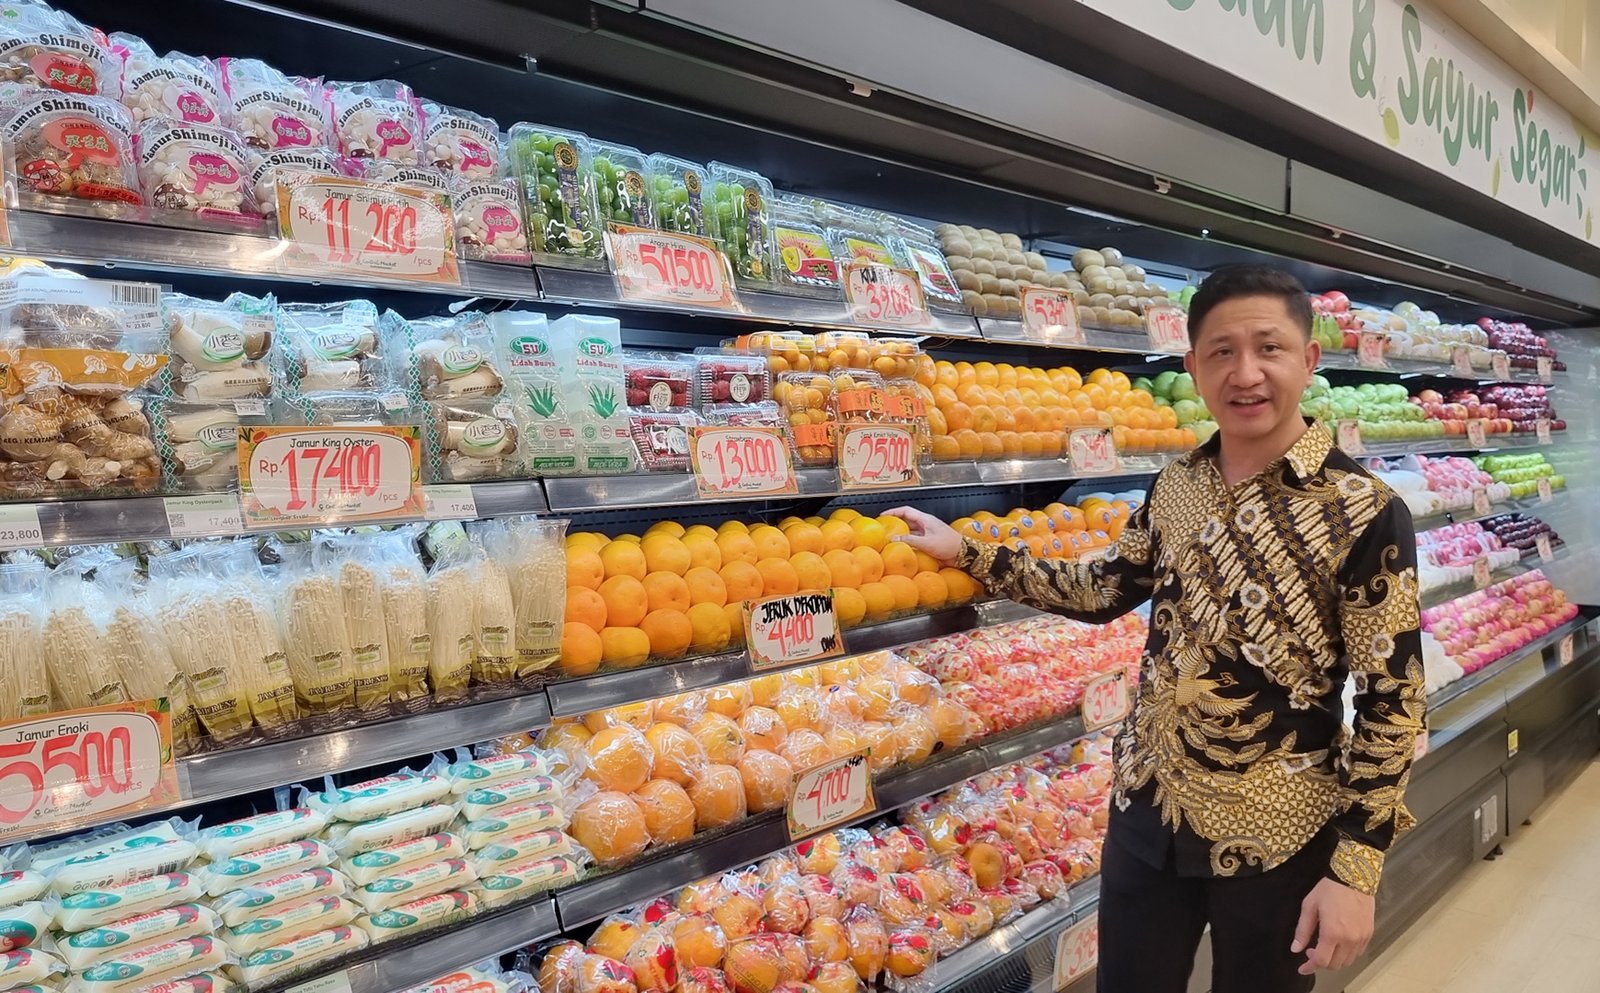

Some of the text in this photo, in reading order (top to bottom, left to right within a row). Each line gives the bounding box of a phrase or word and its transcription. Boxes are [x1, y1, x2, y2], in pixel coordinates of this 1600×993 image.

[39, 33, 99, 60] Shimeji
[1349, 0, 1377, 100] &
[1397, 4, 1499, 167] Sayur
[1510, 87, 1576, 208] Segar
[3, 106, 41, 139] Jamur
[41, 98, 107, 122] Shimeji
[142, 132, 173, 164] Jamur
[171, 129, 229, 150] Shimeji
[270, 153, 322, 170] Shimeji
[398, 170, 441, 187] Shimeji
[325, 189, 353, 202] Jamur
[470, 184, 513, 201] Shimeji
[298, 206, 321, 225] Rp.
[522, 344, 539, 355] SU
[589, 344, 604, 355] SU
[289, 436, 375, 450] Jamur King Oyster
[701, 450, 716, 463] Rp.
[258, 458, 283, 475] Rp.
[378, 491, 398, 503] /pcs
[450, 503, 475, 512] 17,400
[1, 529, 39, 540] 23,800
[755, 622, 768, 635] Rp.
[16, 721, 90, 743] Jamur Enoki
[483, 754, 514, 764] SAKURA
[357, 776, 391, 790] SAKURA
[266, 873, 304, 888] SAKURA
[409, 895, 443, 910] SAKURA
[120, 910, 164, 926] SAKURA
[132, 942, 177, 958] SAKURA
